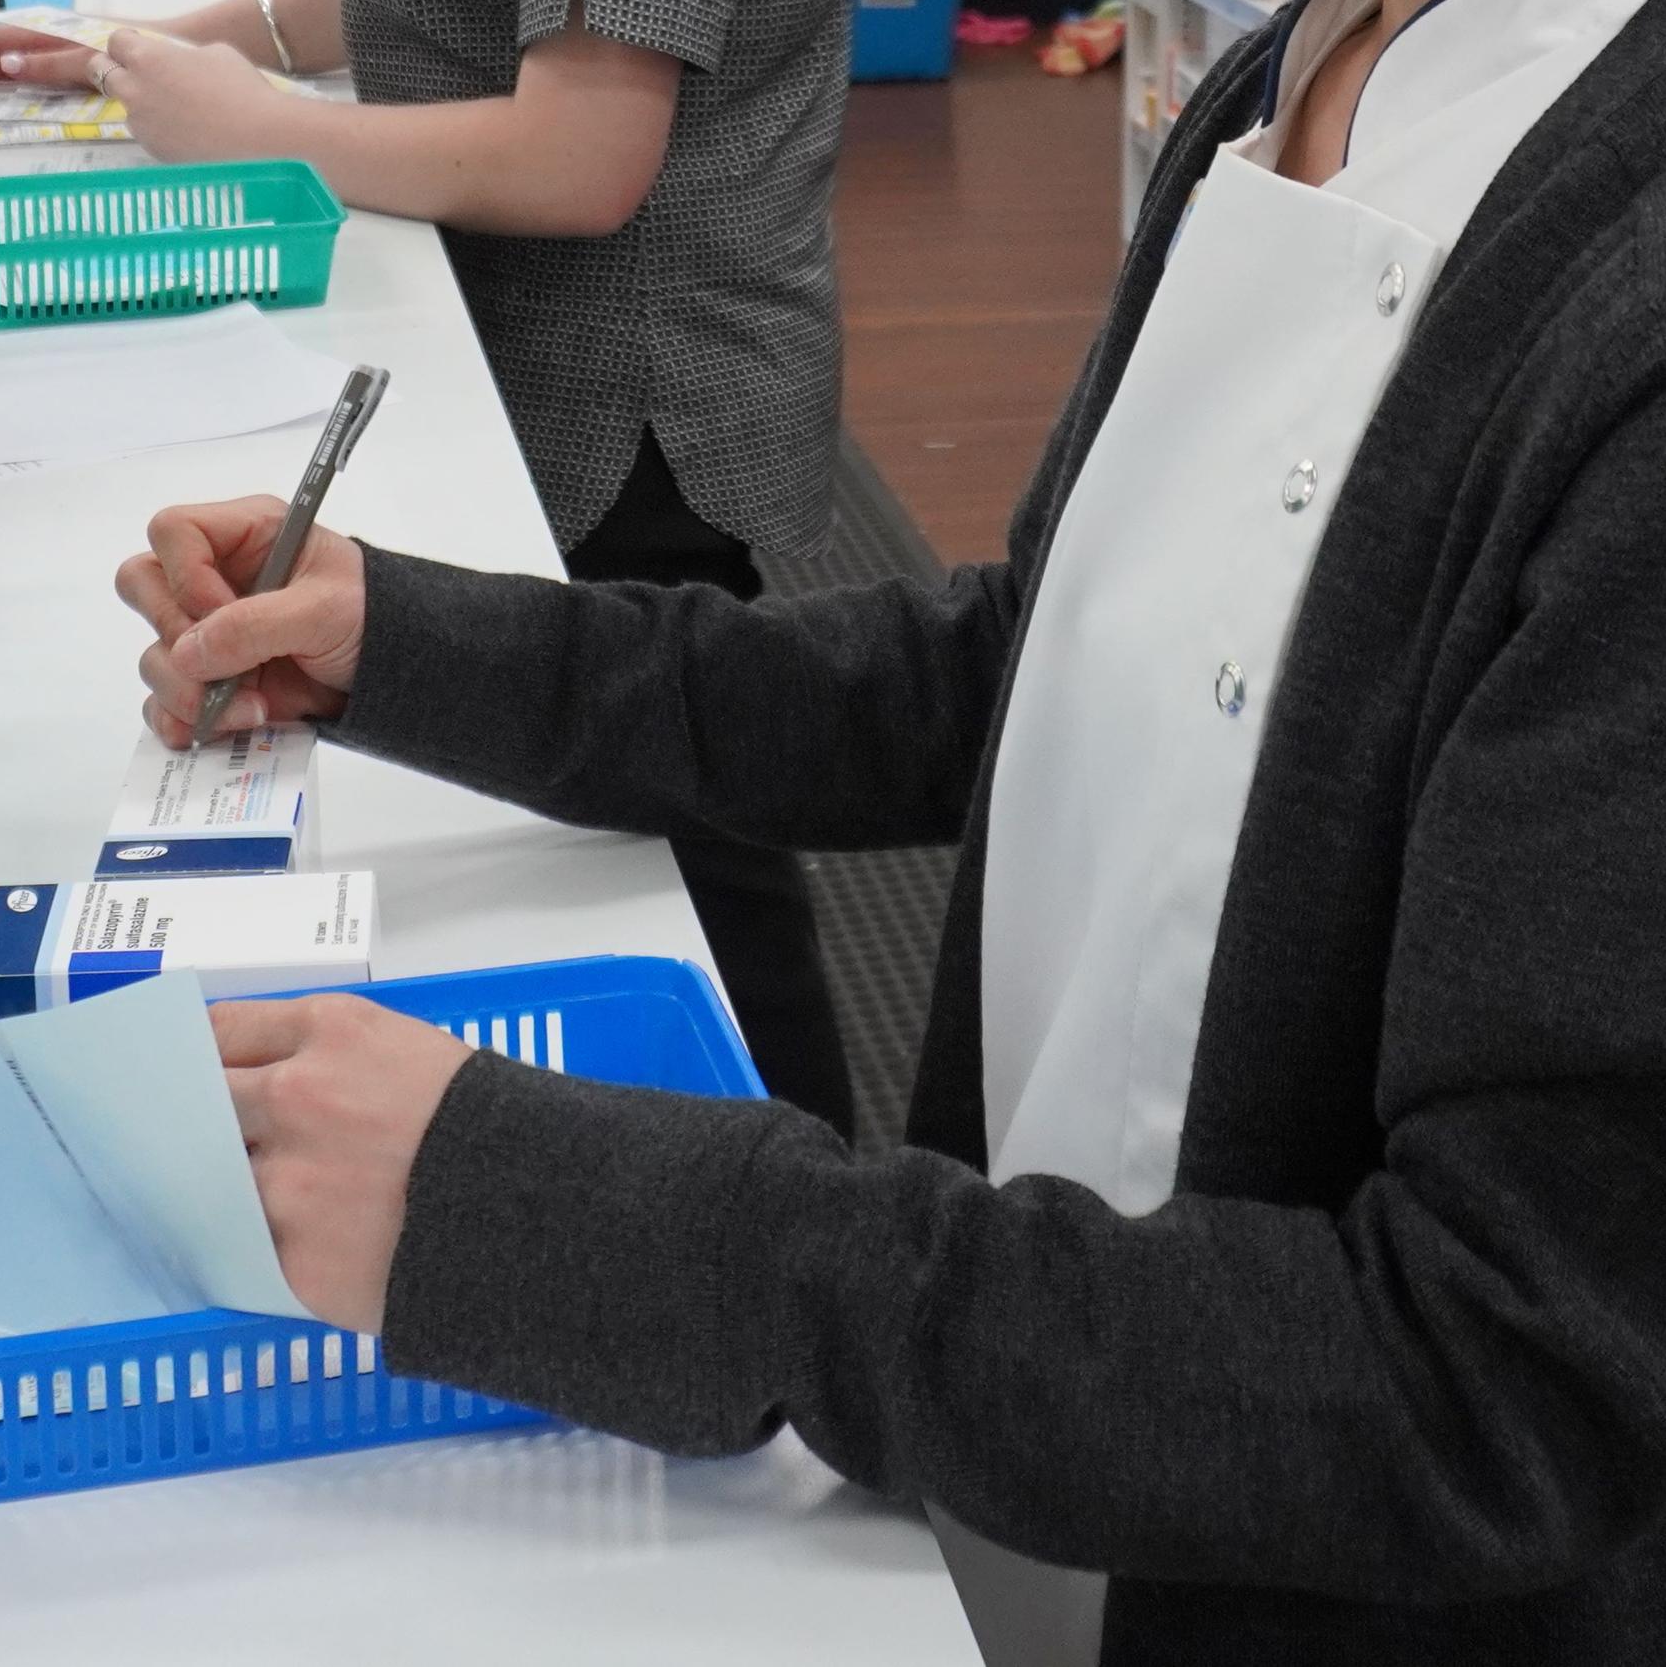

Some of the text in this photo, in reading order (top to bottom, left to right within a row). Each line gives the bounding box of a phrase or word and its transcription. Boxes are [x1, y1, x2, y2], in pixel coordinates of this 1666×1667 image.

[123, 845, 168, 858] Pfizer
[72, 883, 97, 951] PRESCRIPTION ONLY MEDICINE
[126, 896, 150, 949] sulfasalazine
[149, 917, 174, 949] 500 mg
